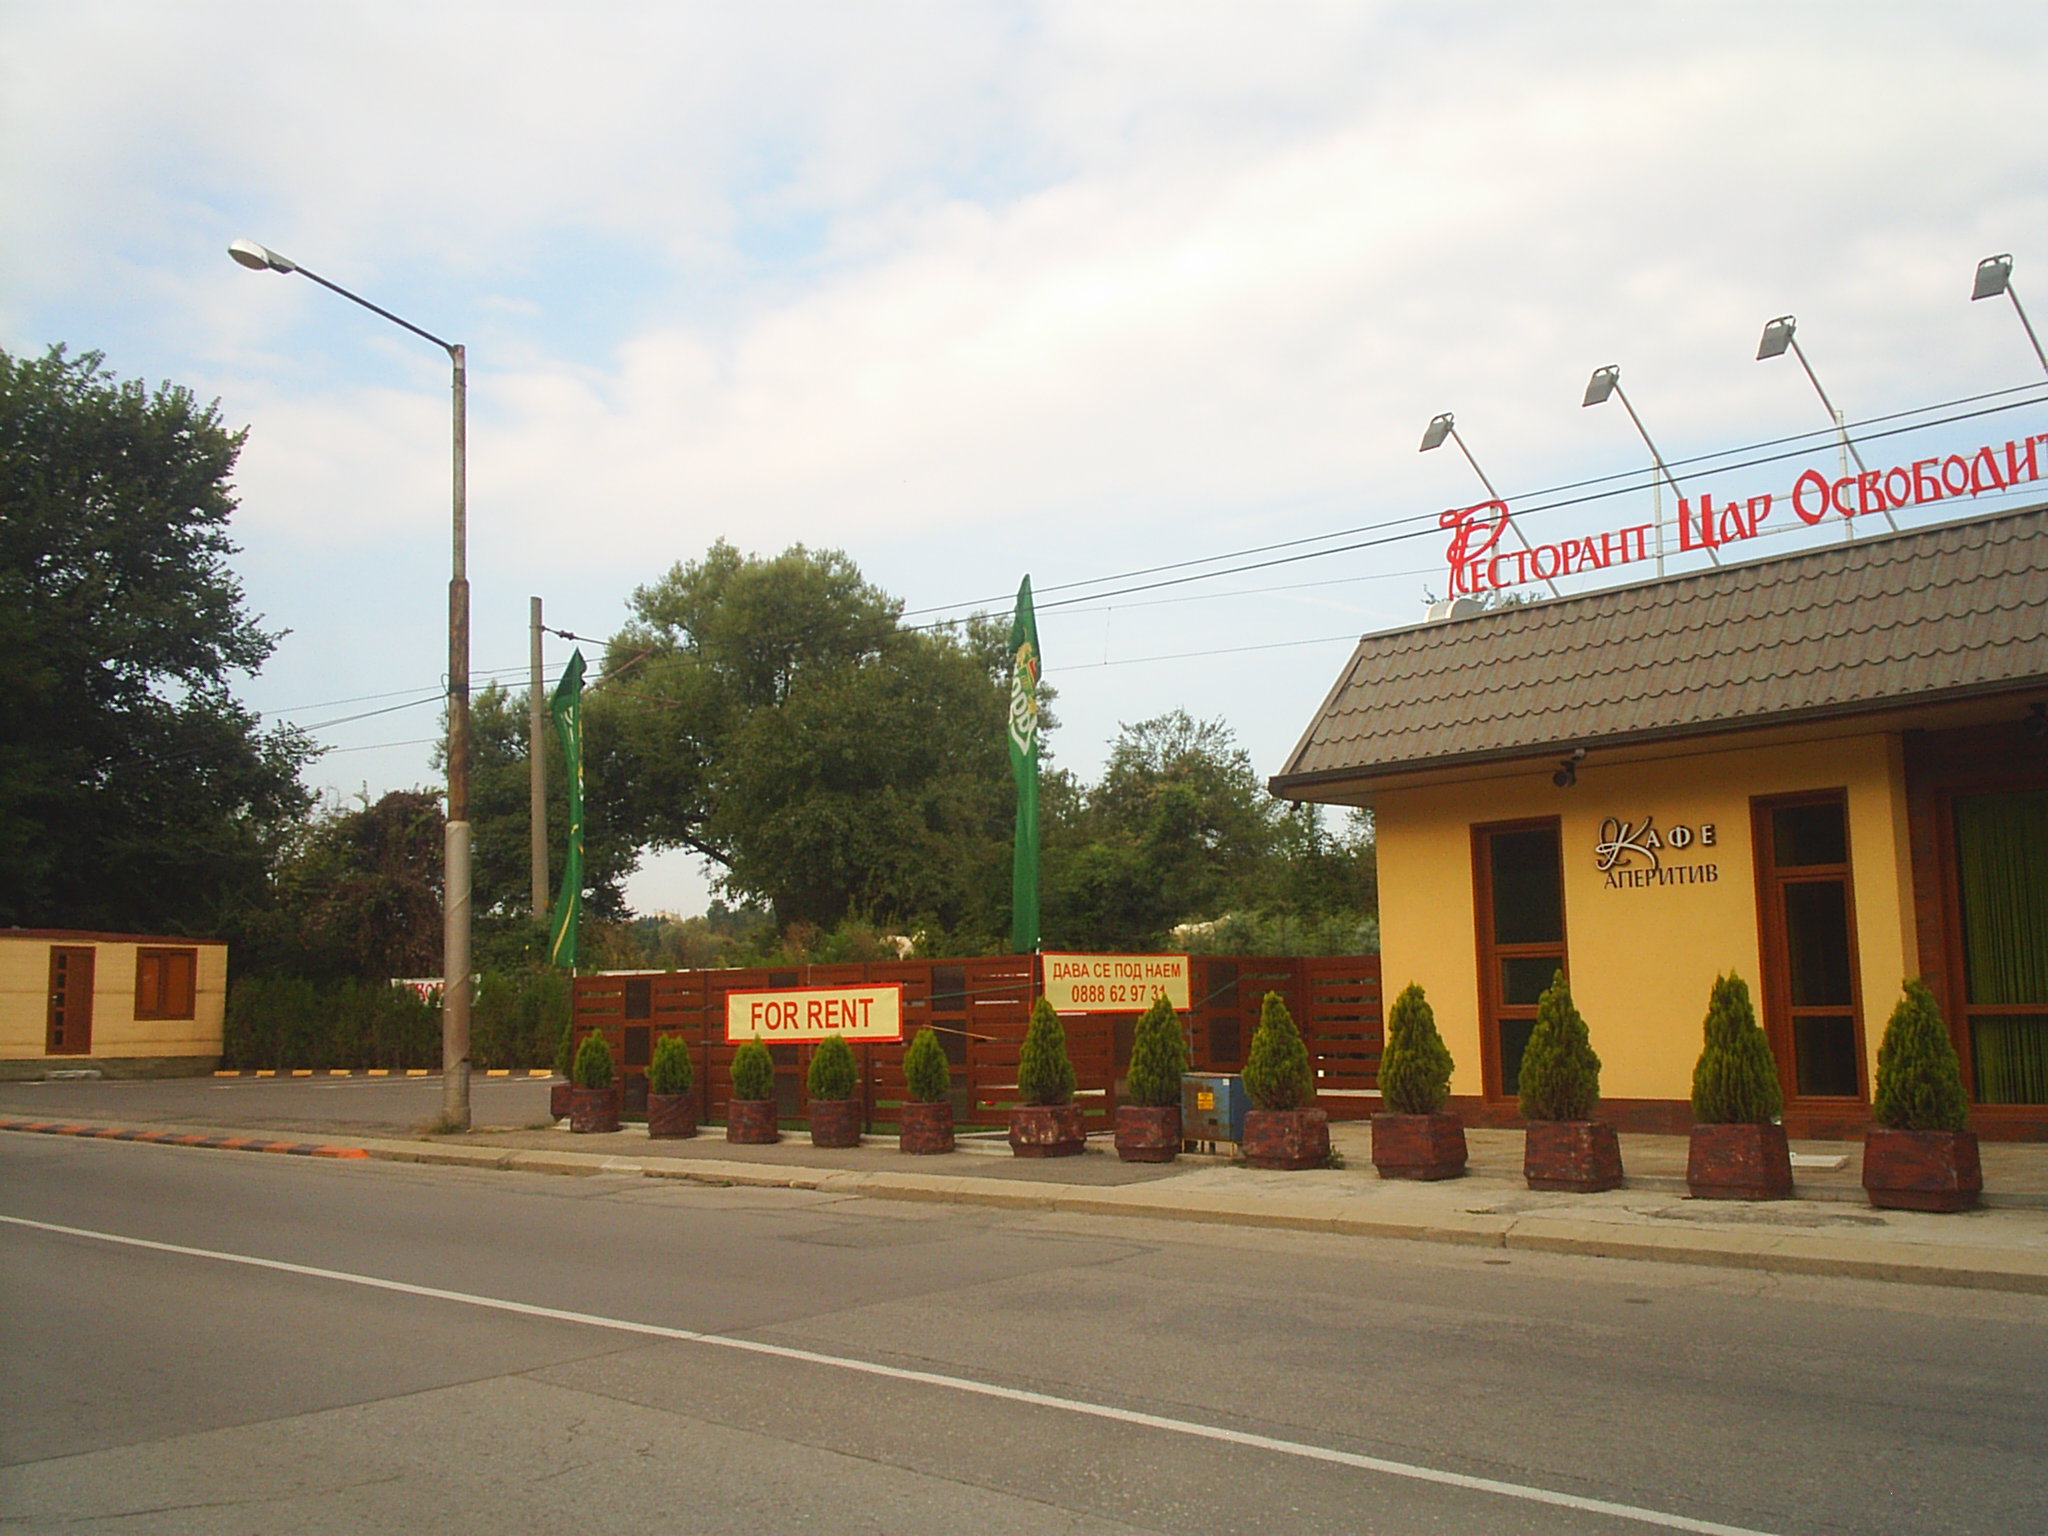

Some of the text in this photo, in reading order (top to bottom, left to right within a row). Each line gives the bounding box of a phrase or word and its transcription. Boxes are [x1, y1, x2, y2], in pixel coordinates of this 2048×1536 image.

[1595, 816, 1716, 871] КАФЕ
[1604, 863, 1718, 889] АПЕРИТИВ
[1053, 963, 1181, 980] ДАВА СЕ ПОД НАЕМ
[1071, 985, 1105, 1002] 0888
[1109, 985, 1126, 1002] 62
[1130, 985, 1146, 1002] 97
[751, 998, 874, 1030] FOR RENT
